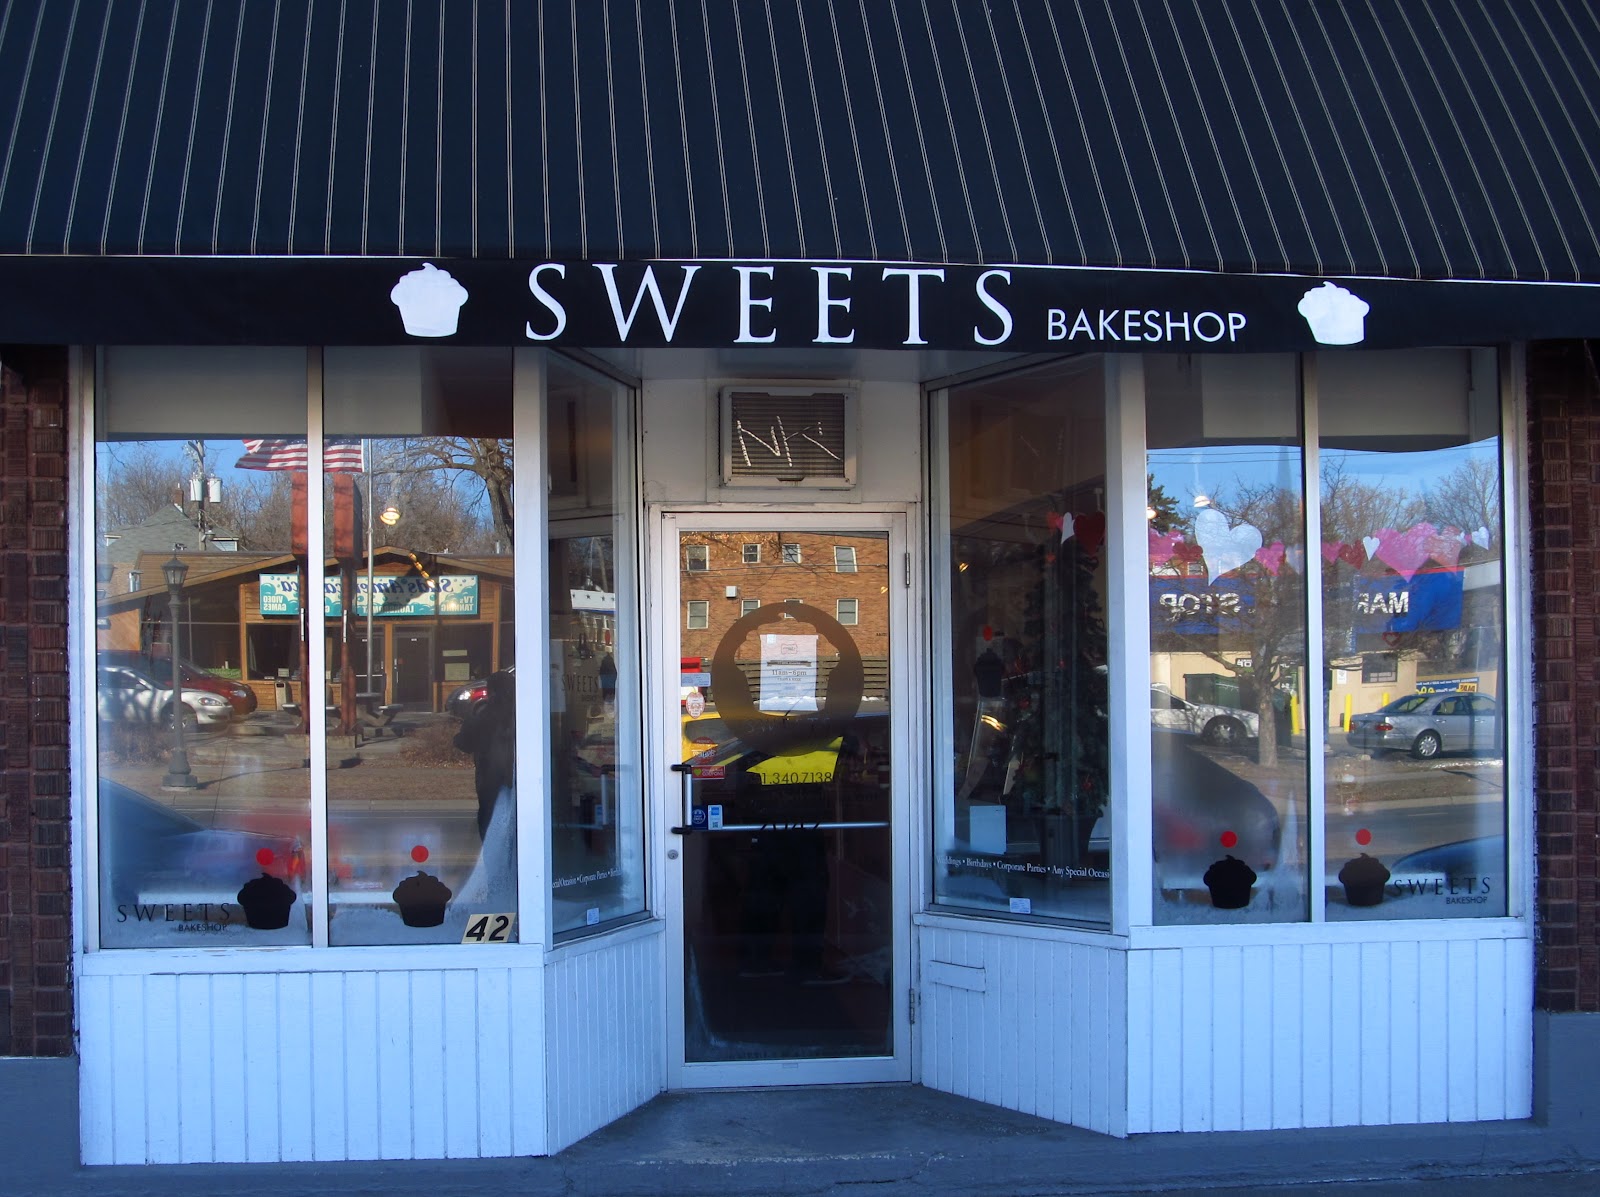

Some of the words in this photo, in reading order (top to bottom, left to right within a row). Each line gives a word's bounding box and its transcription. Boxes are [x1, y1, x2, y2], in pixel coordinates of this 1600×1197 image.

[525, 263, 1014, 346] SWEETS
[1047, 308, 1247, 342] BAKESHOP
[966, 857, 992, 870] Birthdays
[997, 860, 1025, 872] Corporate
[1026, 862, 1047, 874] Parties
[1052, 864, 1065, 878] Any
[1065, 866, 1087, 878] Special
[1088, 868, 1110, 879] Occasi
[1393, 876, 1491, 896] SWEETS
[1446, 897, 1488, 905] BAKESHOP
[117, 903, 231, 923] SWEETS
[178, 924, 228, 932] BAKESHOP
[466, 915, 509, 941] 42
